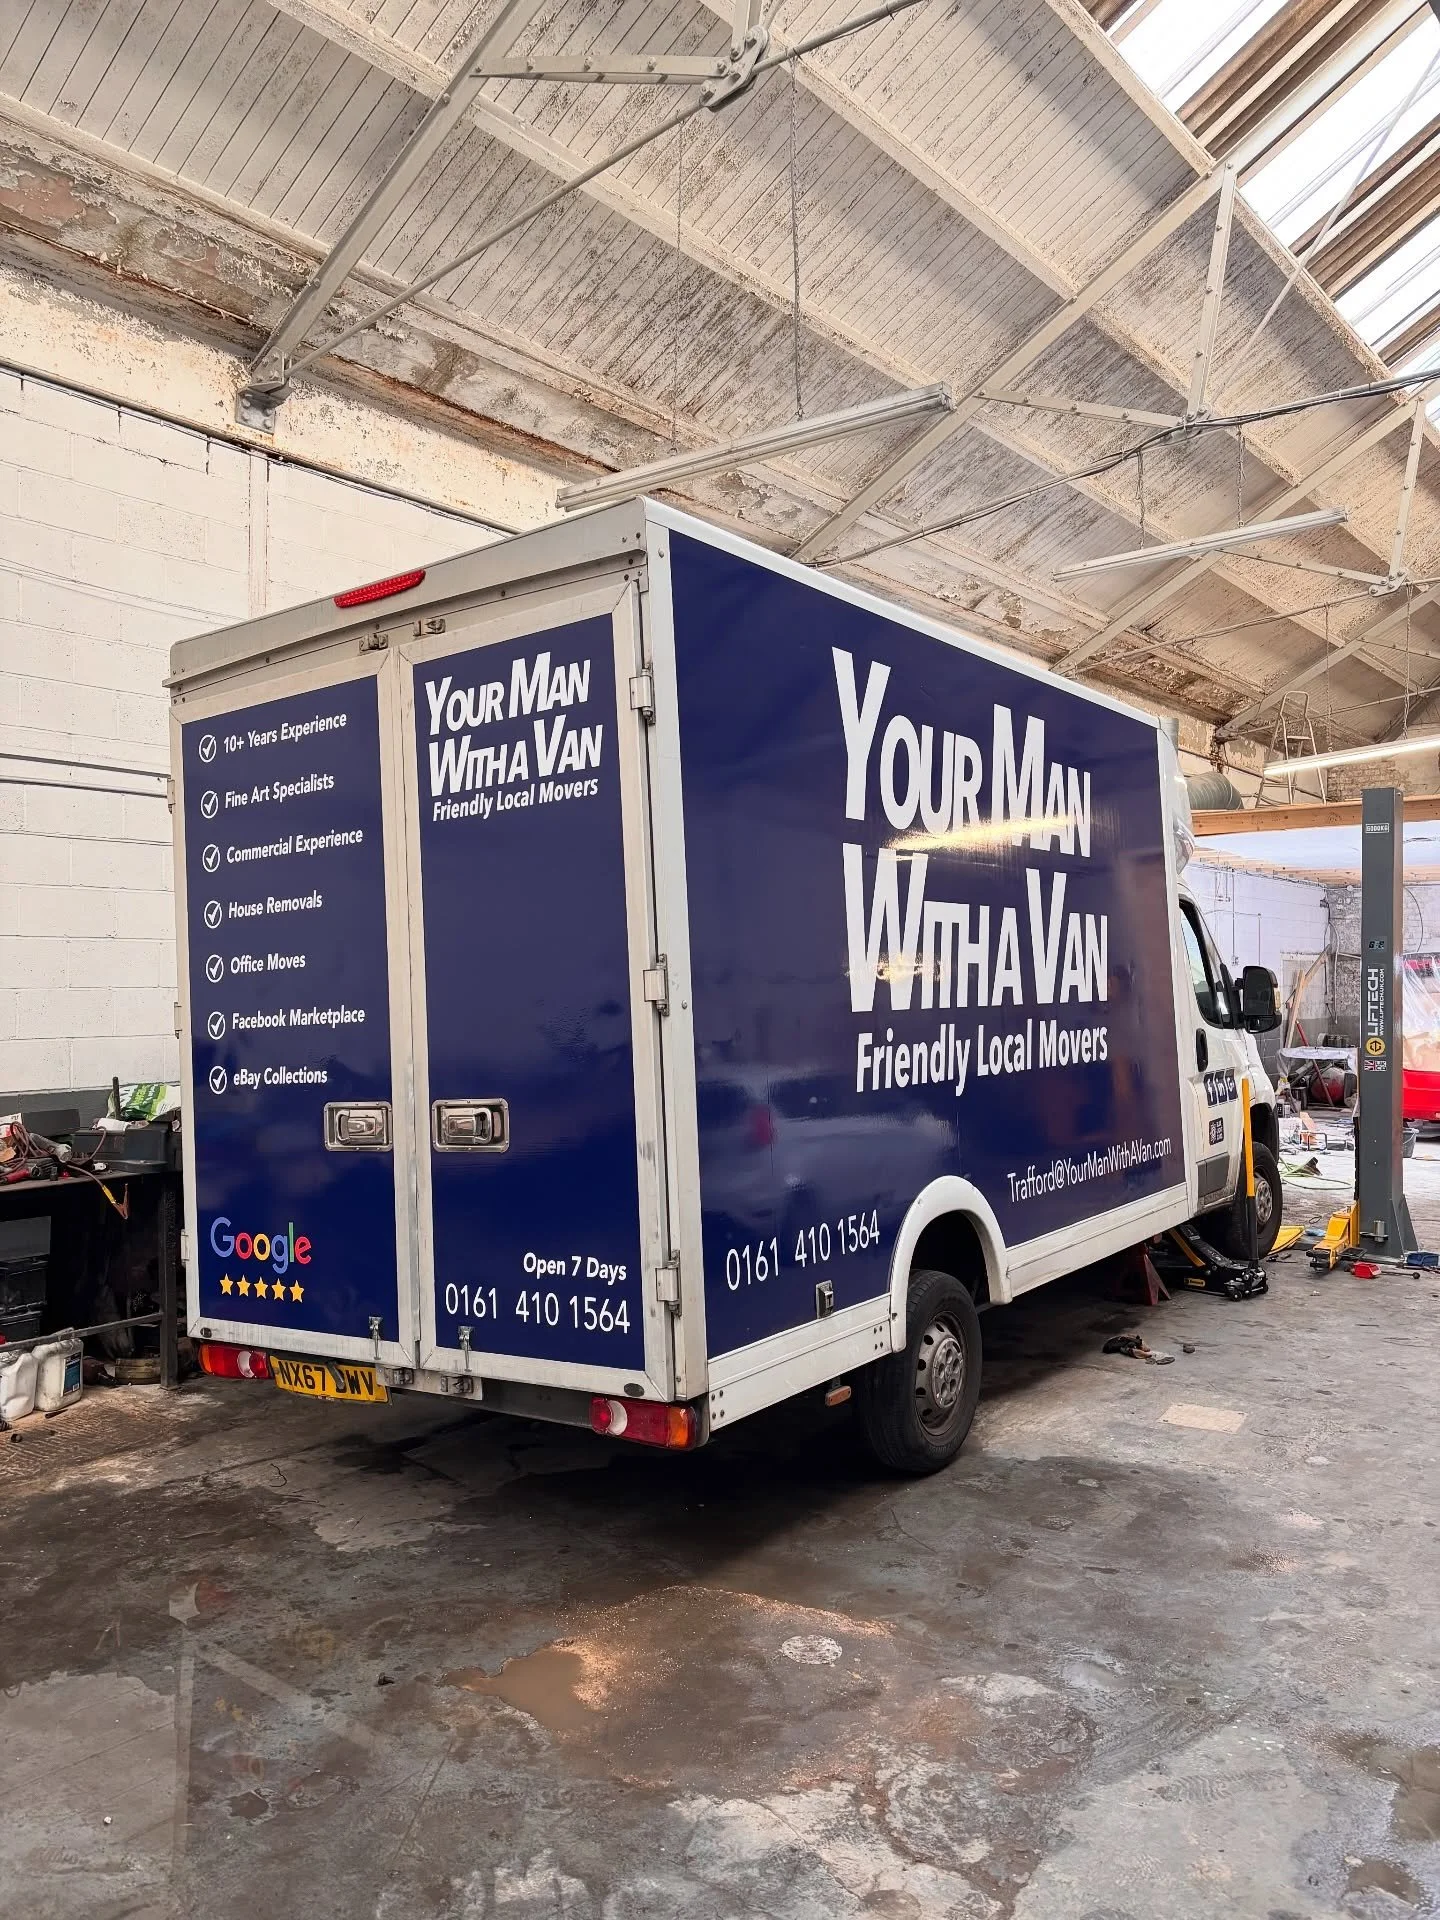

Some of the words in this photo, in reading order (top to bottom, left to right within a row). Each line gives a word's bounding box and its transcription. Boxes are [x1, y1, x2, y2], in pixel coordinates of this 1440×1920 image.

[223, 734, 245, 754] 10+
[247, 729, 278, 749] Years
[280, 713, 347, 743] Experience
[225, 790, 248, 810] Fine
[250, 785, 270, 804] Art
[272, 773, 335, 803] Specialists
[432, 792, 494, 822] Friendly
[496, 783, 536, 812] Local
[538, 778, 599, 804] Movers
[226, 836, 293, 865] Commercial
[295, 827, 363, 856] Experience
[228, 901, 264, 920] House
[266, 889, 323, 915] Removals
[230, 954, 264, 975] Office
[267, 952, 306, 972] Moves
[232, 1009, 287, 1031] Facebook
[289, 1003, 366, 1030] Marketplace
[1367, 968, 1379, 1037] LIFTECH
[856, 1023, 970, 1097] Friendly
[977, 1018, 1033, 1077] Local
[1039, 1018, 1108, 1069] Movers
[233, 1070, 262, 1091] eBay
[263, 1065, 328, 1086] Collections
[1007, 1137, 1172, 1202] Trafford@YourManWithAVan.com
[210, 1216, 312, 1274] Google
[726, 1236, 779, 1291] 0161
[794, 1222, 831, 1268] 410
[837, 1208, 881, 1255] 1564
[523, 1252, 566, 1280] Open
[571, 1255, 582, 1277] 7
[586, 1256, 627, 1286] Days
[445, 1282, 498, 1320] 0161
[515, 1290, 560, 1326] 410
[569, 1295, 631, 1334] 1564
[278, 1360, 326, 1392] NX67
